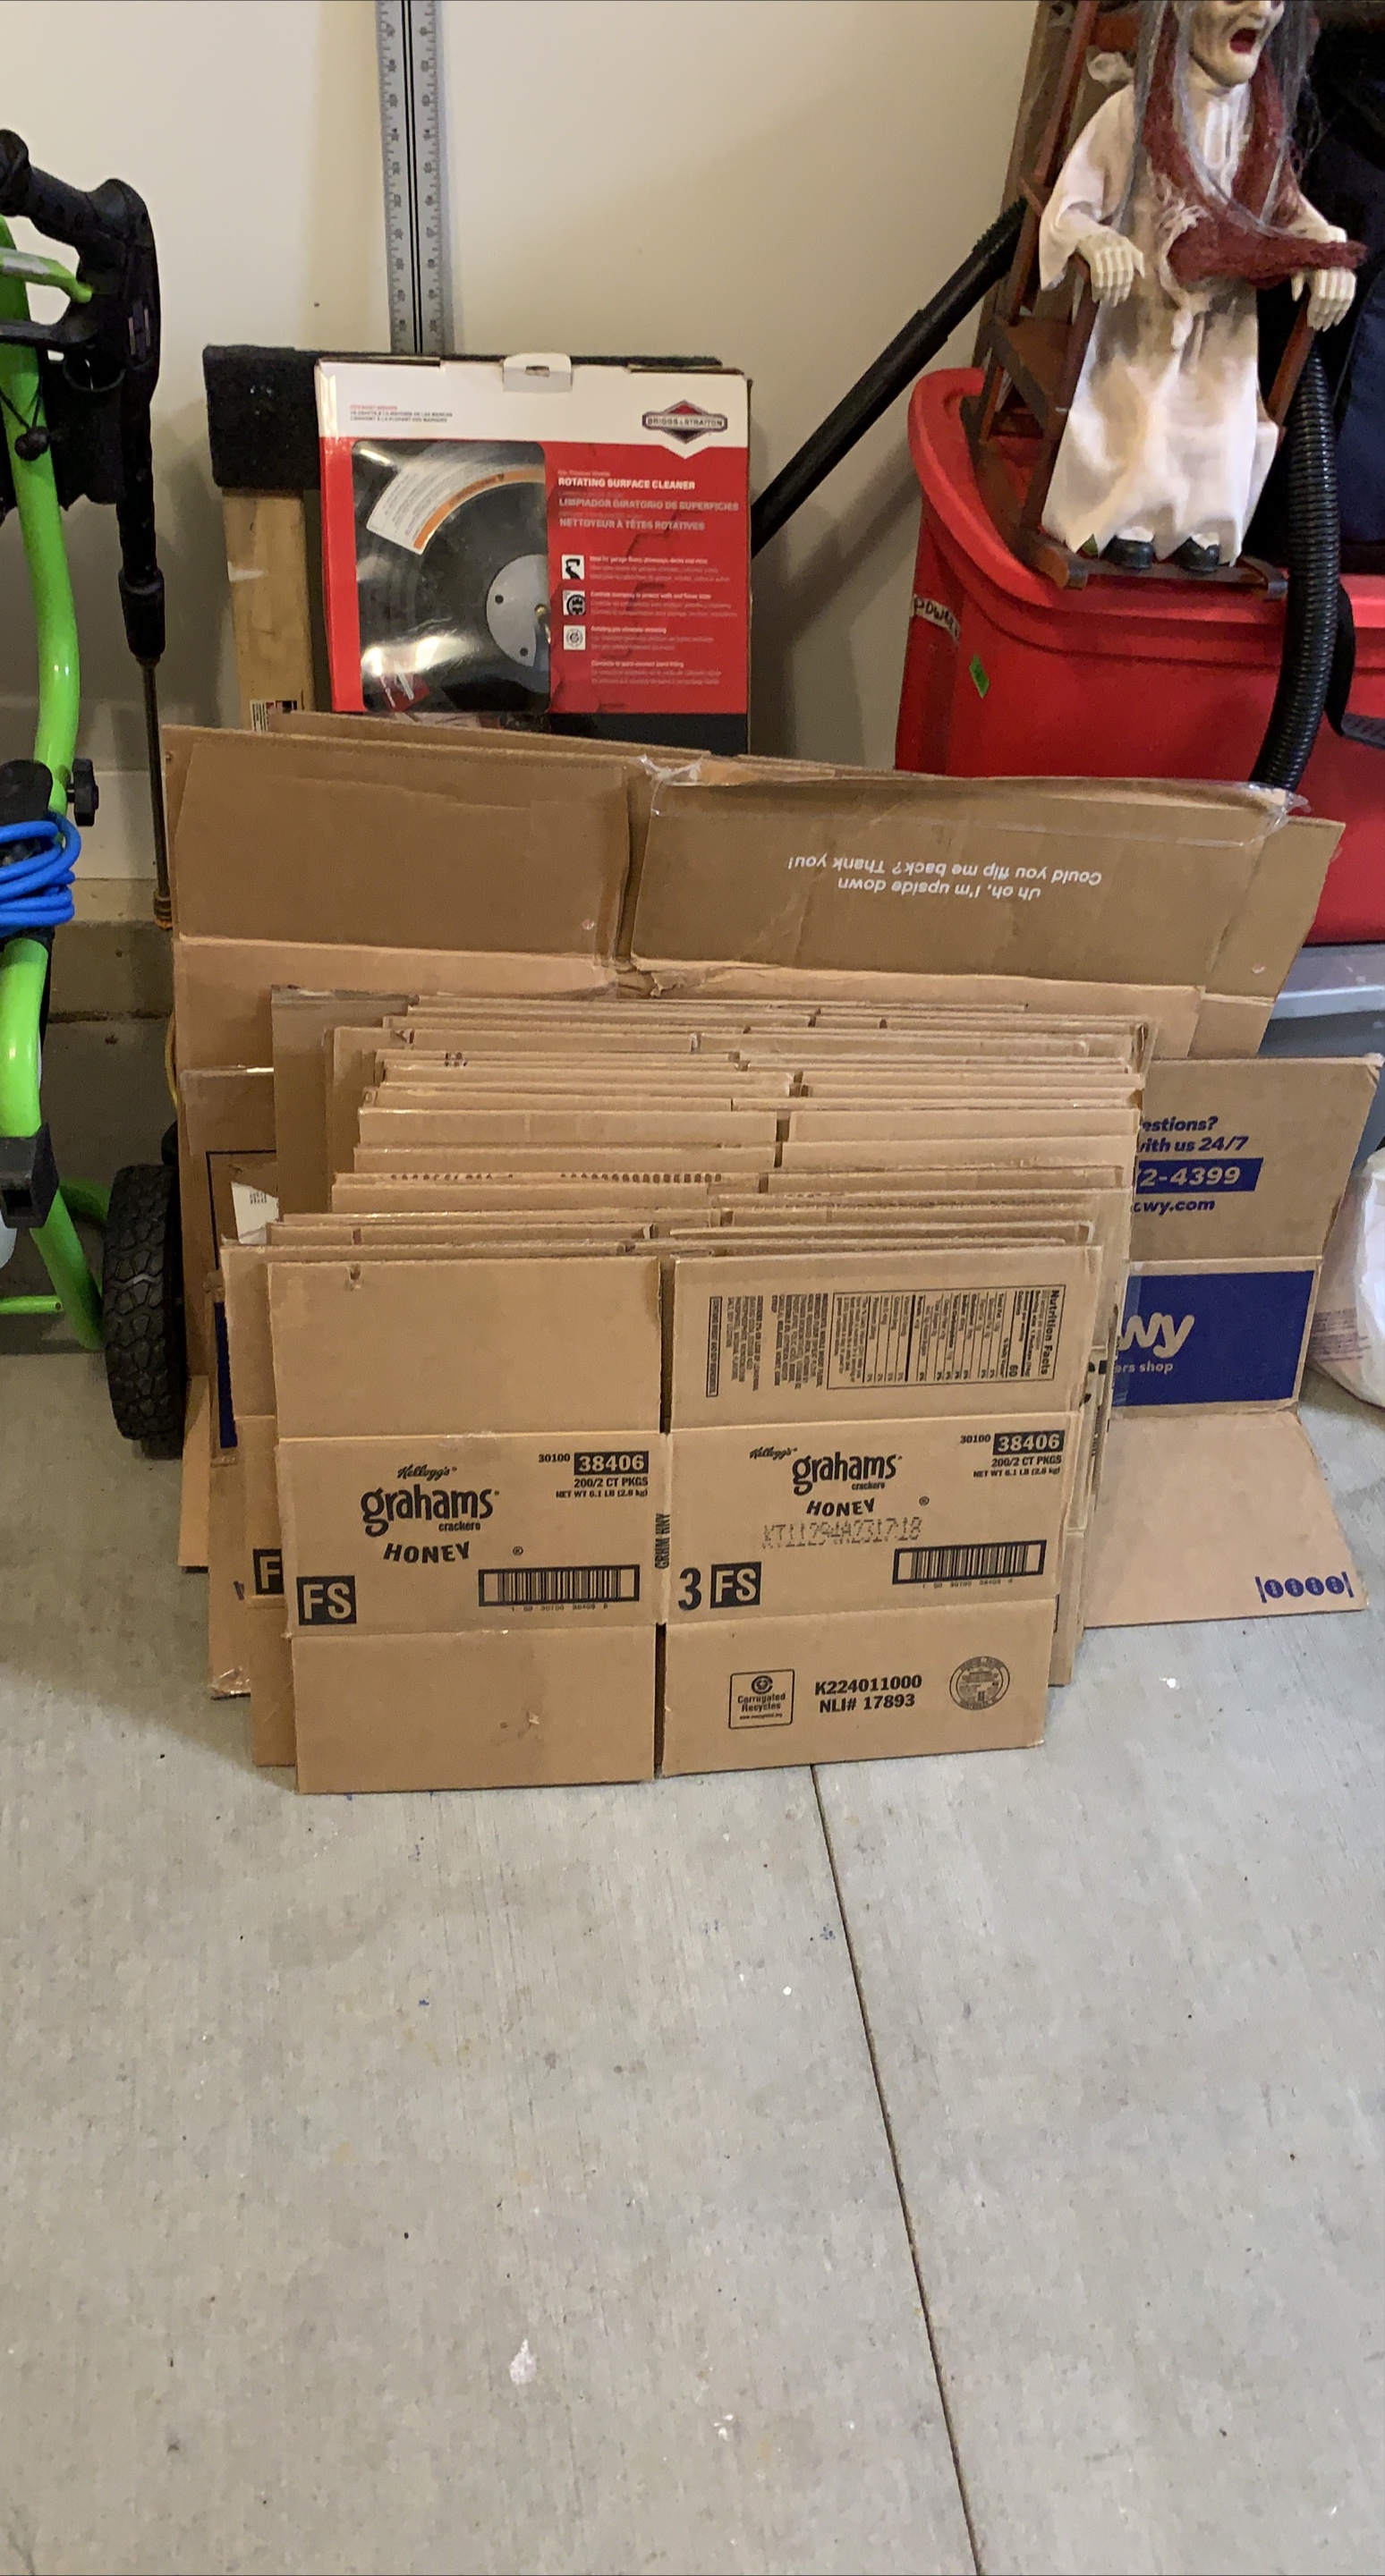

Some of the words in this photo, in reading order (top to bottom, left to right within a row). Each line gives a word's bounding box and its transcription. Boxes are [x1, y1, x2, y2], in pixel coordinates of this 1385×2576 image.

[557, 477, 606, 487] ROTATING
[607, 478, 650, 489] SURFACE
[651, 479, 695, 490] CLEANER
[558, 498, 611, 509] LIMPIADOR
[613, 499, 663, 510] GIRATORIO
[665, 501, 677, 510] DE
[679, 501, 739, 512] SUPERFICIES
[559, 519, 615, 529] NETTOYEUR
[625, 518, 653, 530] TÊTES
[655, 521, 705, 530] ROTATIVES
[787, 853, 828, 869] you!
[832, 857, 886, 874] Thank
[891, 861, 947, 877] back?
[951, 863, 978, 877] me
[982, 862, 1010, 880] flip
[1015, 866, 1049, 880] you
[1050, 869, 1102, 886] Could
[837, 877, 887, 894] down
[891, 877, 950, 895] upside
[955, 884, 981, 898] I'm
[1017, 886, 1041, 901] Uh
[1174, 1140, 1194, 1153] us
[1198, 1136, 1250, 1152] 24/7
[1138, 1166, 1241, 1187] 2-4399
[1045, 1290, 1060, 1342] Nutrition
[1041, 1344, 1053, 1375] Facts
[1009, 1364, 1018, 1377] 60
[1139, 1360, 1174, 1376] shop
[960, 1434, 990, 1444] 30100
[998, 1433, 1060, 1453] 38406
[538, 1453, 571, 1463] 30100
[578, 1454, 645, 1472] 38406
[991, 1457, 1019, 1468] 200/2
[1022, 1456, 1034, 1466] CT
[1037, 1454, 1062, 1465] PKGS
[792, 1452, 896, 1496] grahams
[973, 1470, 988, 1478] NET
[574, 1478, 604, 1488] 200/2
[606, 1478, 618, 1487] CT
[621, 1477, 649, 1487] PKGS
[851, 1481, 885, 1491] crackers
[556, 1490, 572, 1498] NET
[574, 1490, 587, 1498] WT
[604, 1489, 615, 1497] LB
[360, 1483, 493, 1538] grahams
[806, 1497, 875, 1517] HONEY
[438, 1521, 481, 1532] crackers
[383, 1540, 470, 1563] HONEY
[677, 1567, 702, 1611] 3
[715, 1568, 757, 1604] FS
[302, 1582, 352, 1620] FS
[814, 1674, 922, 1696] K224011000
[737, 1692, 786, 1704] Corrugated
[820, 1697, 857, 1714] NLI#
[863, 1693, 915, 1710] 17893
[741, 1702, 781, 1713] Recycles
